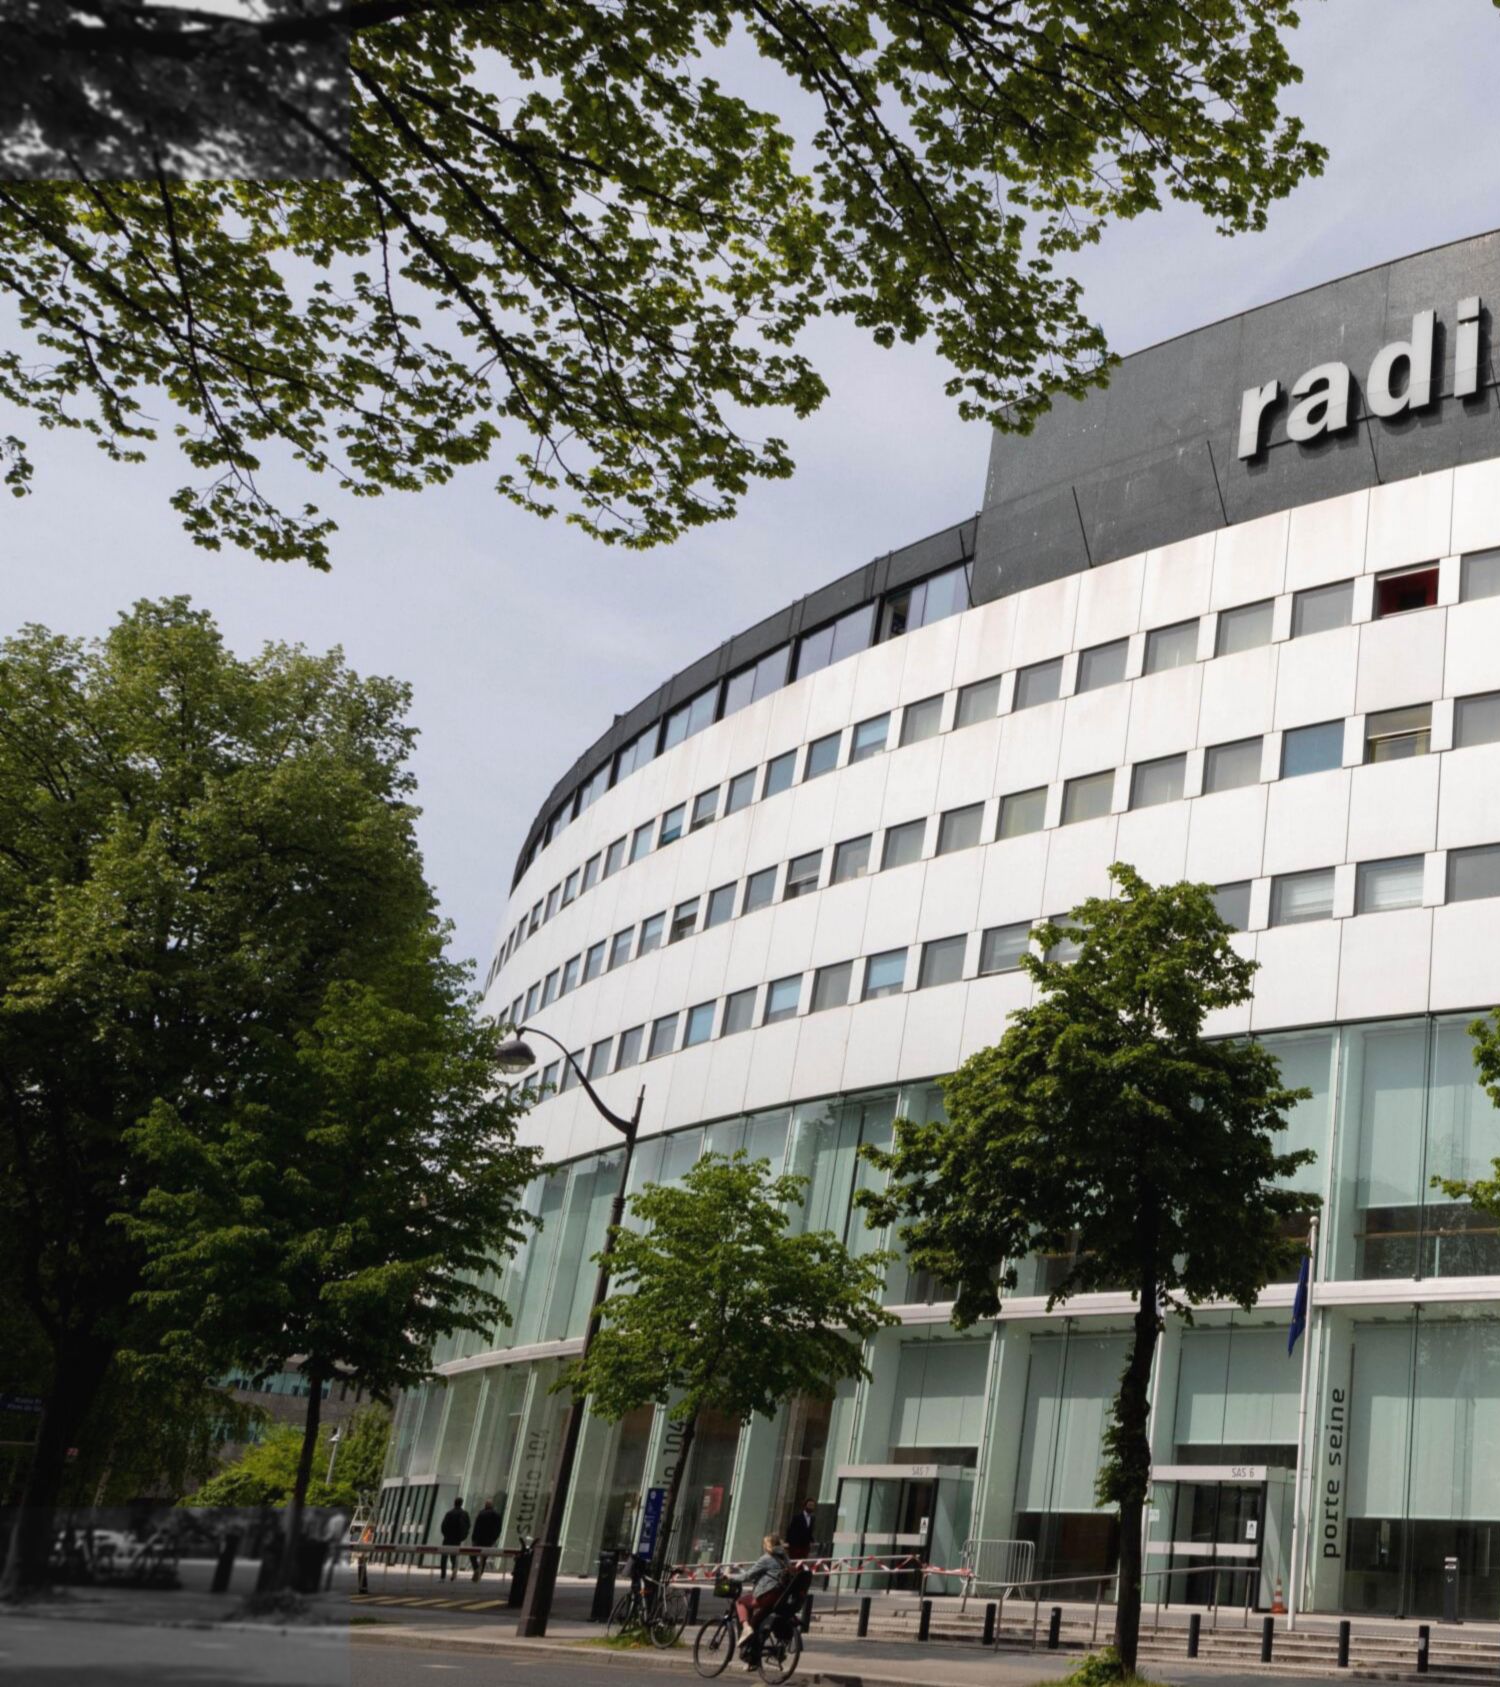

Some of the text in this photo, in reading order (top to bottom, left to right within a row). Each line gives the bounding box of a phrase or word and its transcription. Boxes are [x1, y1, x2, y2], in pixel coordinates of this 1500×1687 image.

[516, 1469, 542, 1536] studio
[1231, 1467, 1247, 1478] SAS
[1323, 1387, 1345, 1559] porte seine
